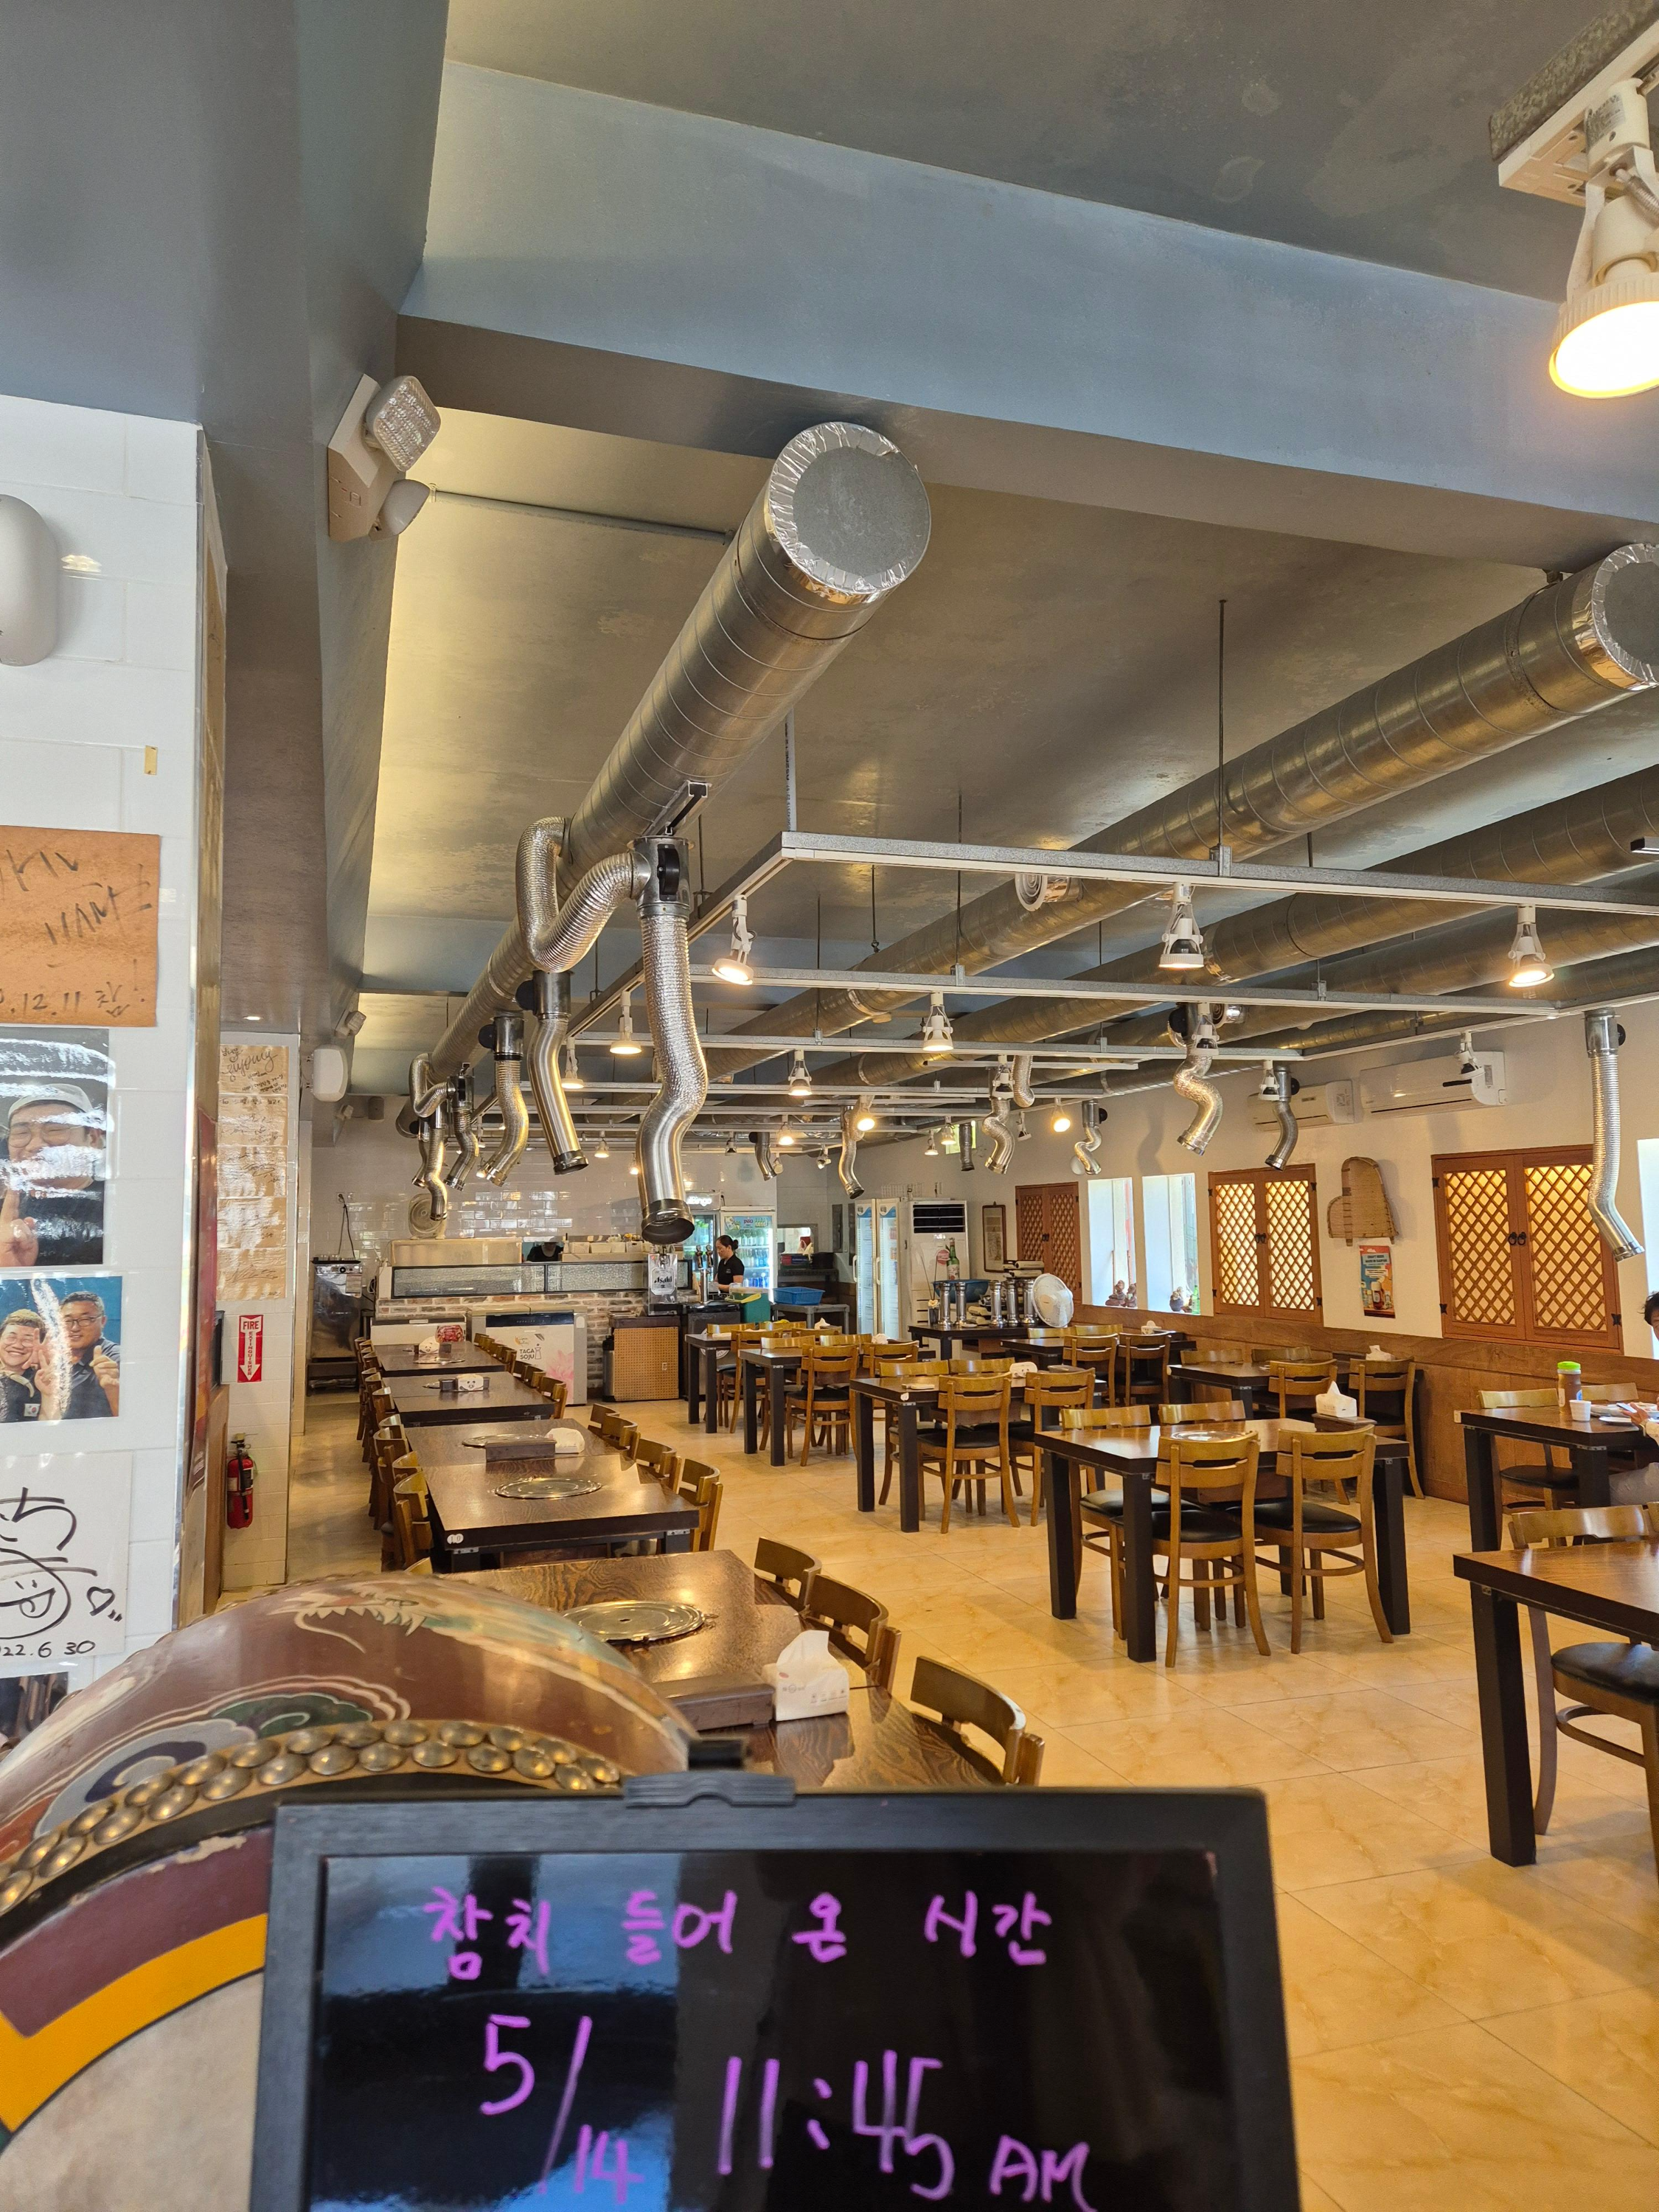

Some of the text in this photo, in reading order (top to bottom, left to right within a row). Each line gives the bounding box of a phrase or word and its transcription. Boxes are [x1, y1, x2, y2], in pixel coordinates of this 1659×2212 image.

[243, 1321, 259, 1330] FIRE
[0, 1641, 96, 1658] 22.6 30
[422, 1886, 1053, 1980] 참치 들어 온 시간
[480, 2014, 1098, 2212] 5/14 11:45 AM
